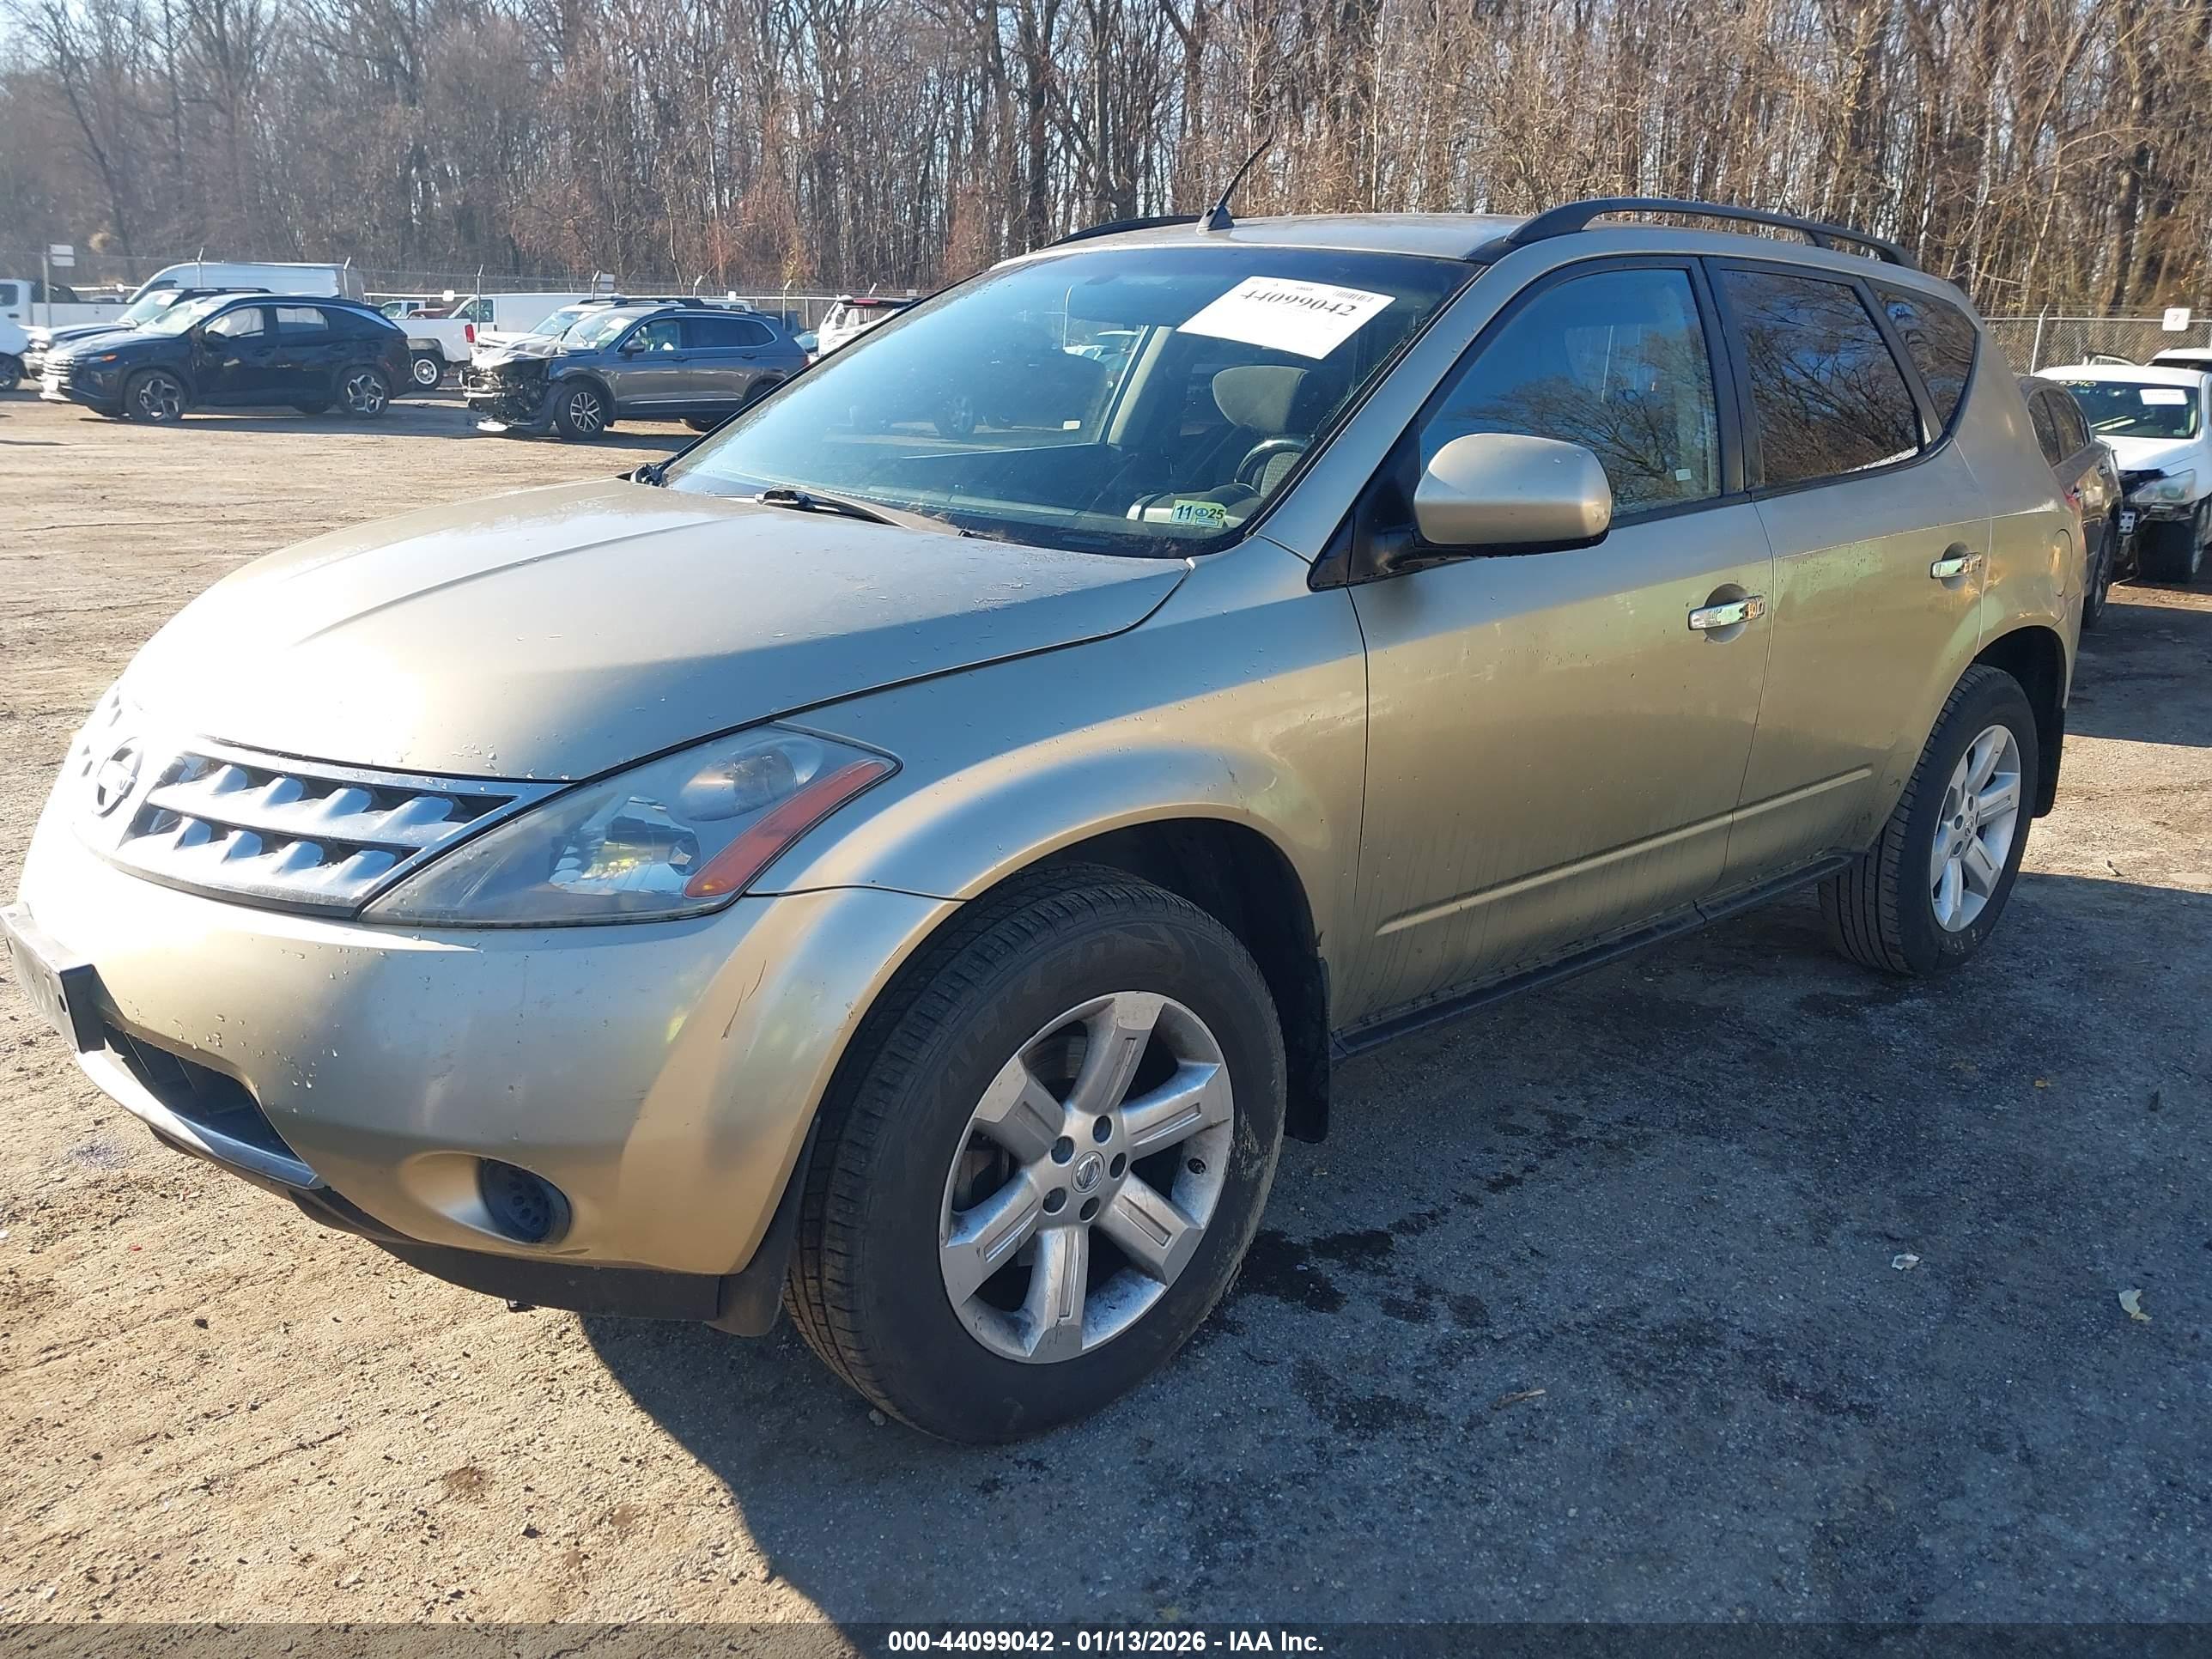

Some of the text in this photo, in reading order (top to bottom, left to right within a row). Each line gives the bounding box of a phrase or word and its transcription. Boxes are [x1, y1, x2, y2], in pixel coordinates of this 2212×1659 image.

[1241, 289, 1358, 316] 44099042
[1177, 505, 1224, 520] 11 25
